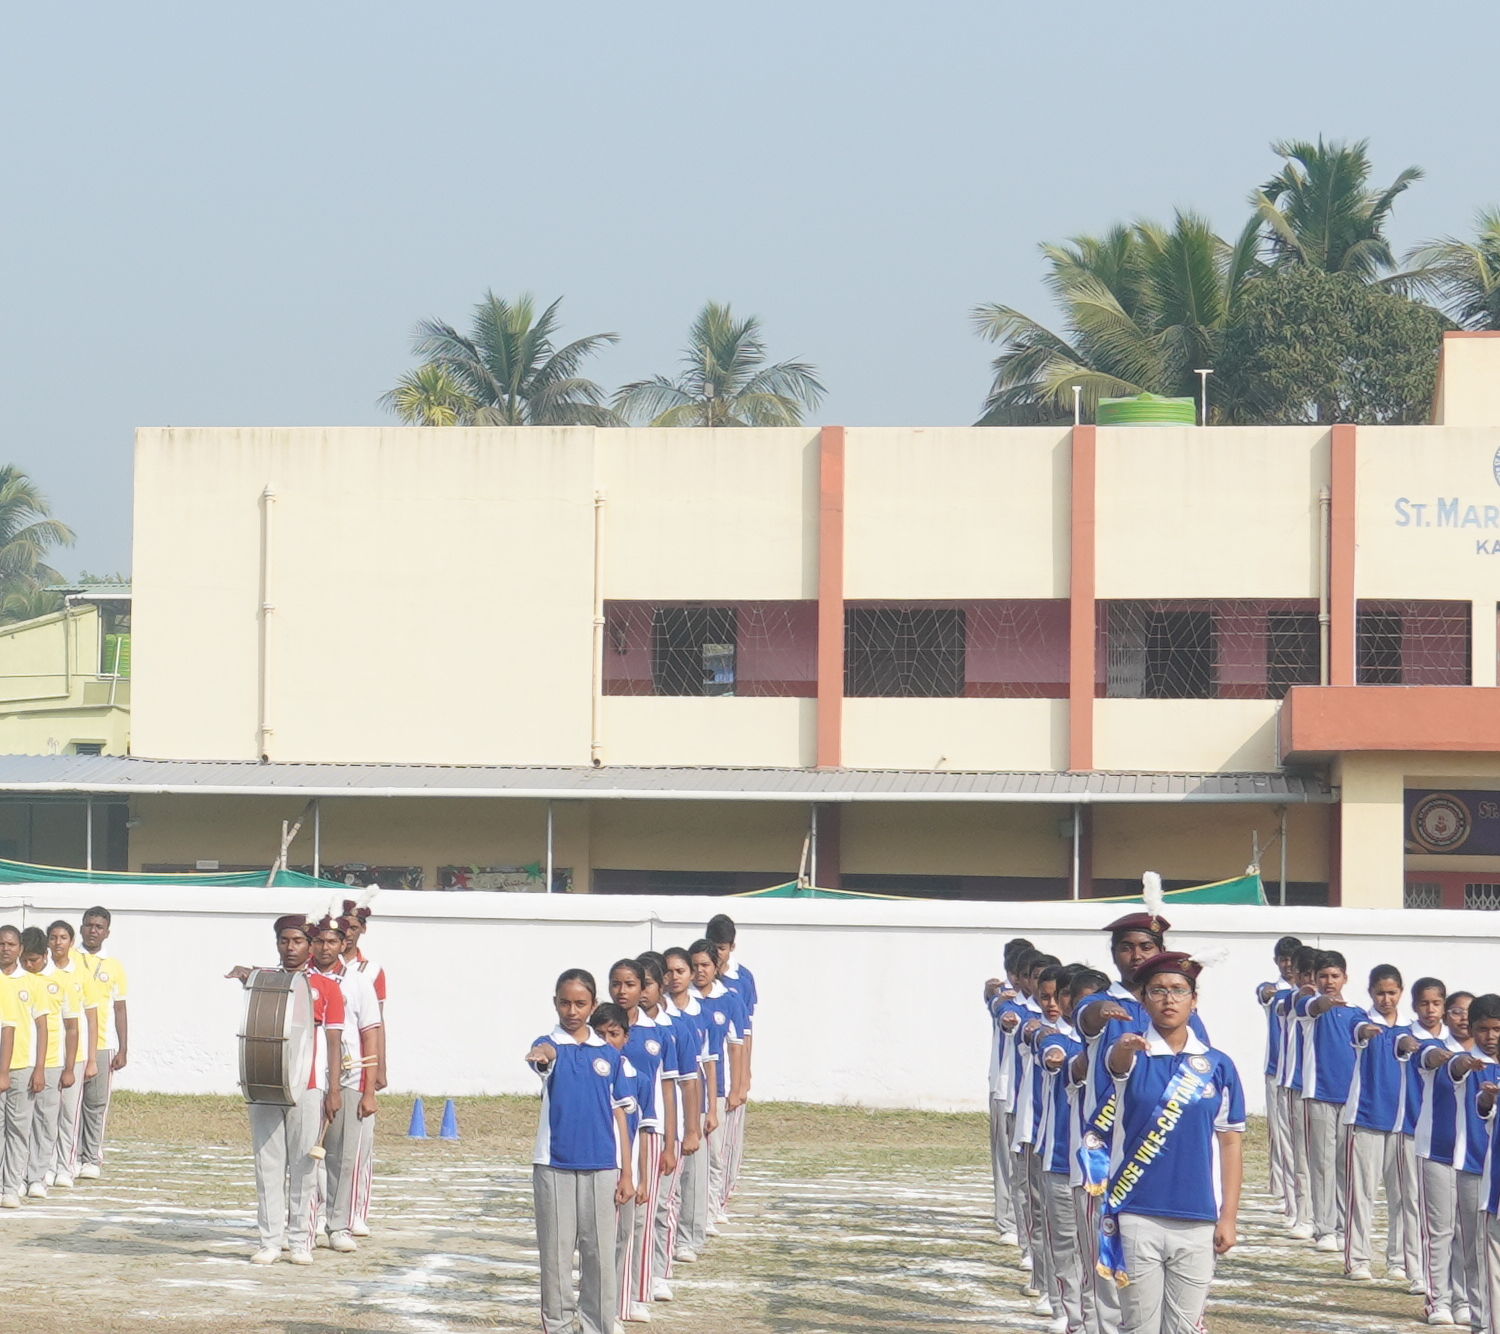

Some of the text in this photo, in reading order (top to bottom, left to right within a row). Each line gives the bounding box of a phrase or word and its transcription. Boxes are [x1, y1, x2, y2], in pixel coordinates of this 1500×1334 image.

[1394, 497, 1431, 527] ST.
[1478, 800, 1499, 819] ST.
[1108, 1161, 1145, 1209] HOUSE
[1134, 1071, 1201, 1165] VICE-CAPTAIN
